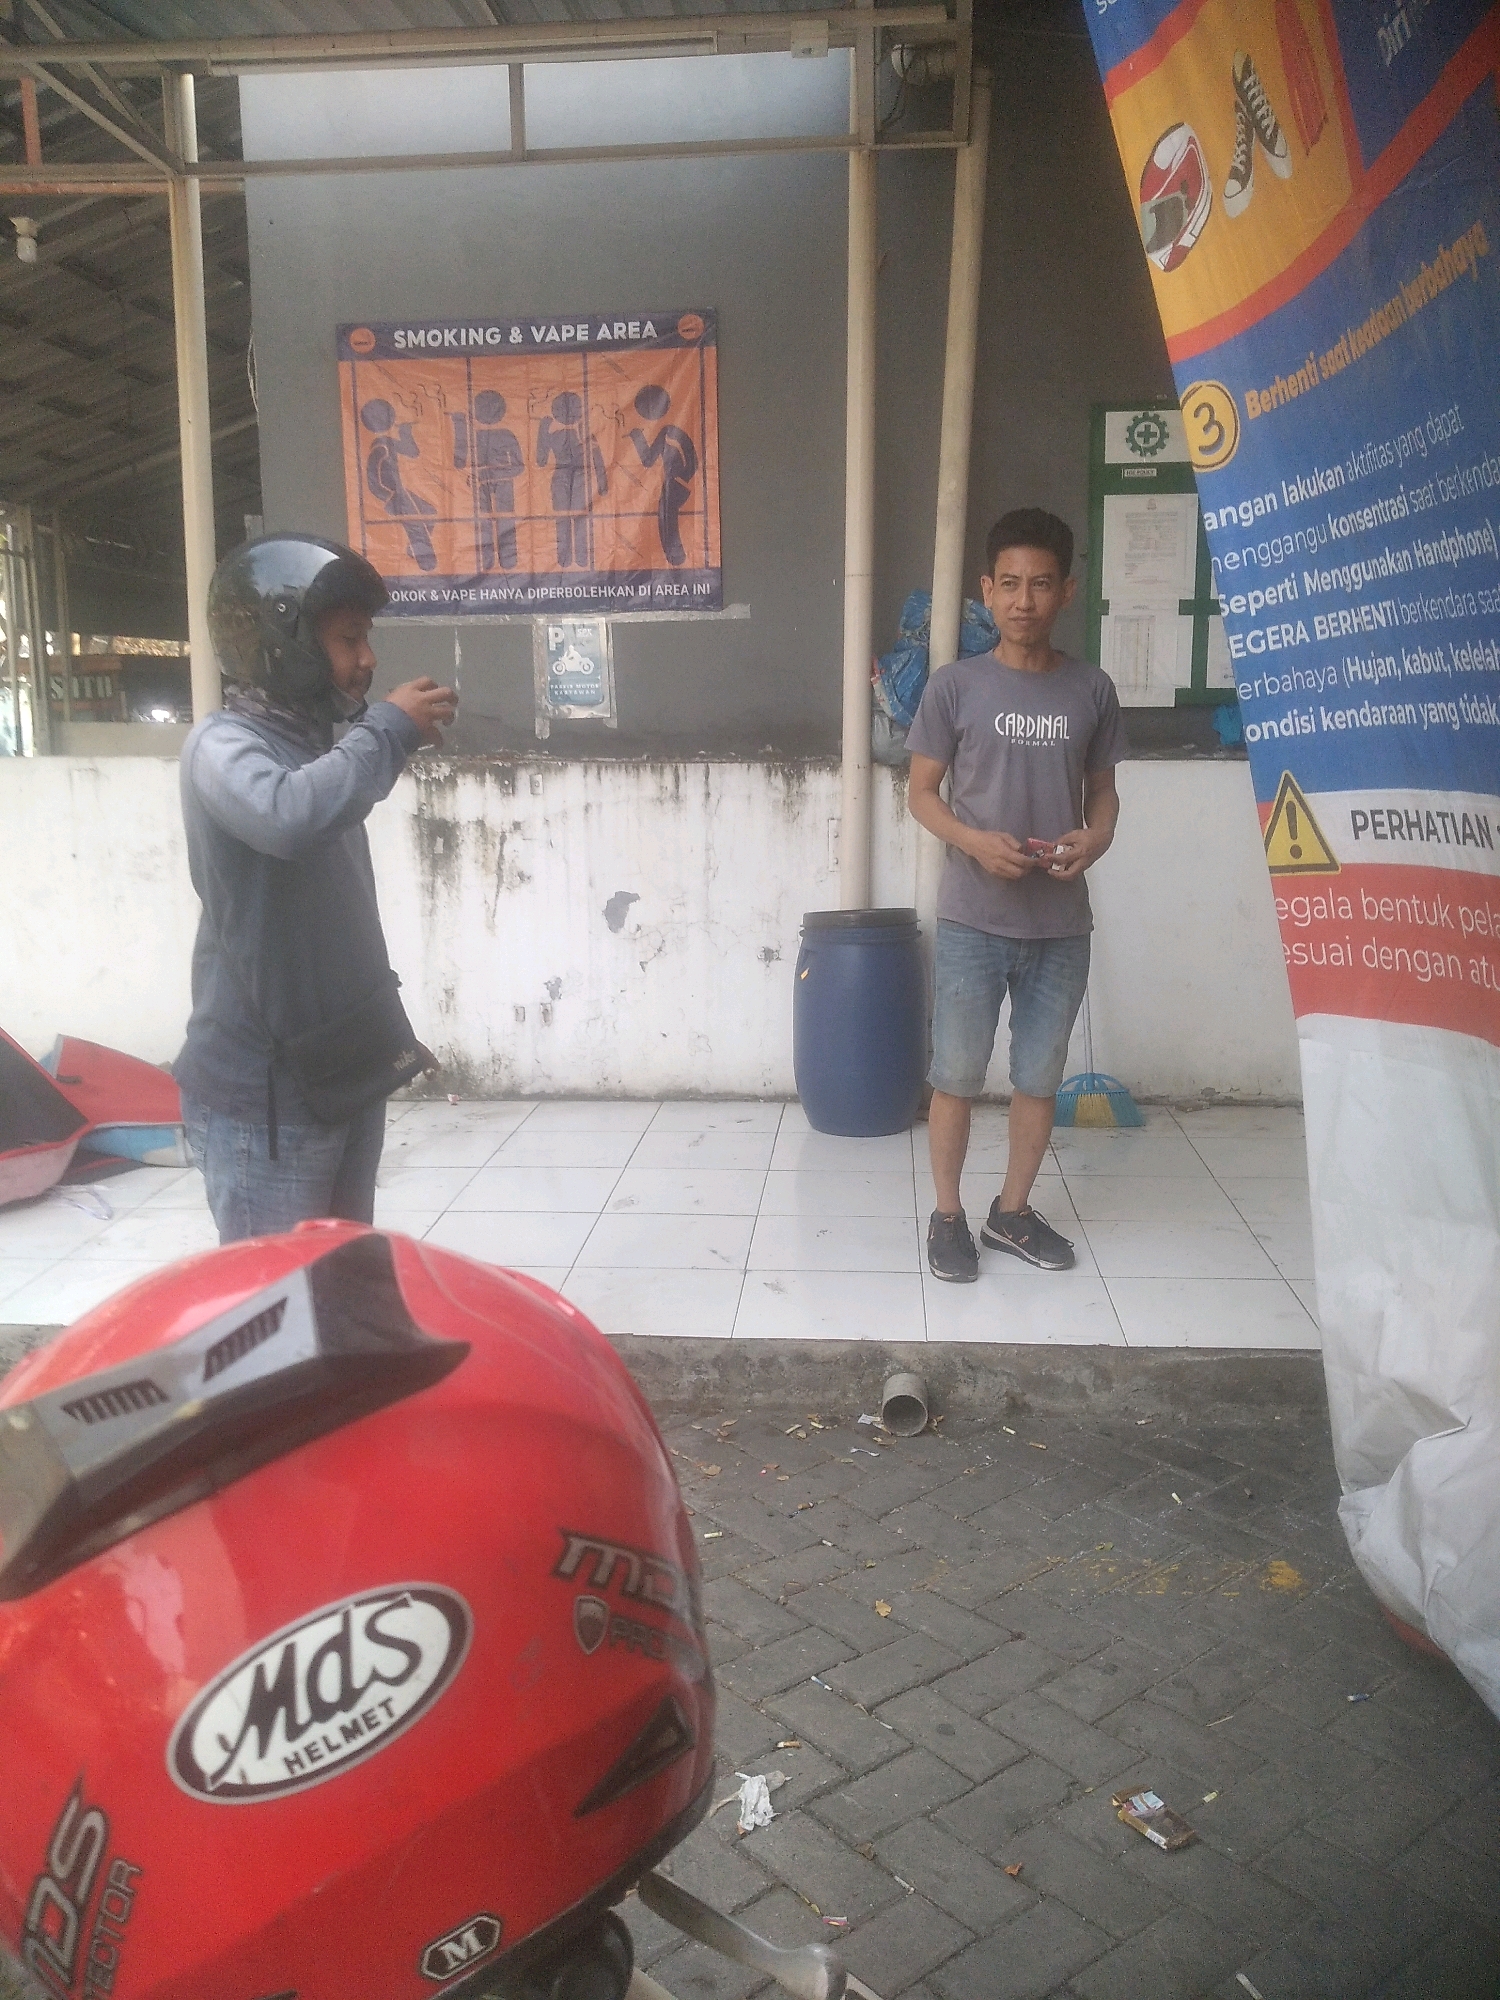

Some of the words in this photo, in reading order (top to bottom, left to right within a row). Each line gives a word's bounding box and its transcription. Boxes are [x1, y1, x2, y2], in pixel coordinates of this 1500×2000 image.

[393, 327, 501, 349] SMOKING
[509, 326, 523, 344] &
[530, 323, 589, 343] VAPE
[596, 320, 658, 340] AREA
[1244, 351, 1320, 420] Berhenti
[1319, 334, 1351, 380] saat
[1193, 402, 1225, 456] 3
[1203, 491, 1278, 531] angan
[1281, 464, 1346, 507] lakukan
[1346, 441, 1395, 482] aktifitas
[1393, 425, 1428, 468] yang
[1426, 402, 1465, 445] dapat
[1327, 484, 1410, 540] konsentrasi
[1409, 479, 1438, 513] saat
[388, 590, 427, 602] OKOK
[430, 589, 439, 601] &
[442, 588, 477, 601] VAPE
[480, 588, 524, 600] HANYA
[527, 585, 635, 599] DIPERBOLEHKAN
[638, 585, 651, 596] DI
[655, 584, 689, 596] AREA
[692, 583, 710, 595] INI
[1218, 572, 1299, 617] Seperti
[1303, 546, 1413, 596] Menggunakan
[548, 627, 565, 651] P
[1228, 620, 1310, 659] EGERA
[1313, 598, 1400, 640] BERHENTI
[1397, 586, 1478, 626] berkendara
[1236, 666, 1338, 700] erbahaya
[994, 712, 1070, 740] CARDINAL
[1243, 706, 1316, 743] ondisi
[1320, 700, 1417, 731] kendaraan
[1418, 701, 1460, 731] yang
[1459, 692, 1500, 726] tidak
[1010, 738, 1056, 747] FORMAL
[1350, 809, 1494, 850] PERHATIAN
[1275, 887, 1353, 927] egala
[1360, 887, 1454, 929] bentuk
[1281, 935, 1353, 967] esuai
[1362, 937, 1463, 982] dengan
[282, 1696, 397, 1775] HELMET
[440, 1925, 486, 1970] M
